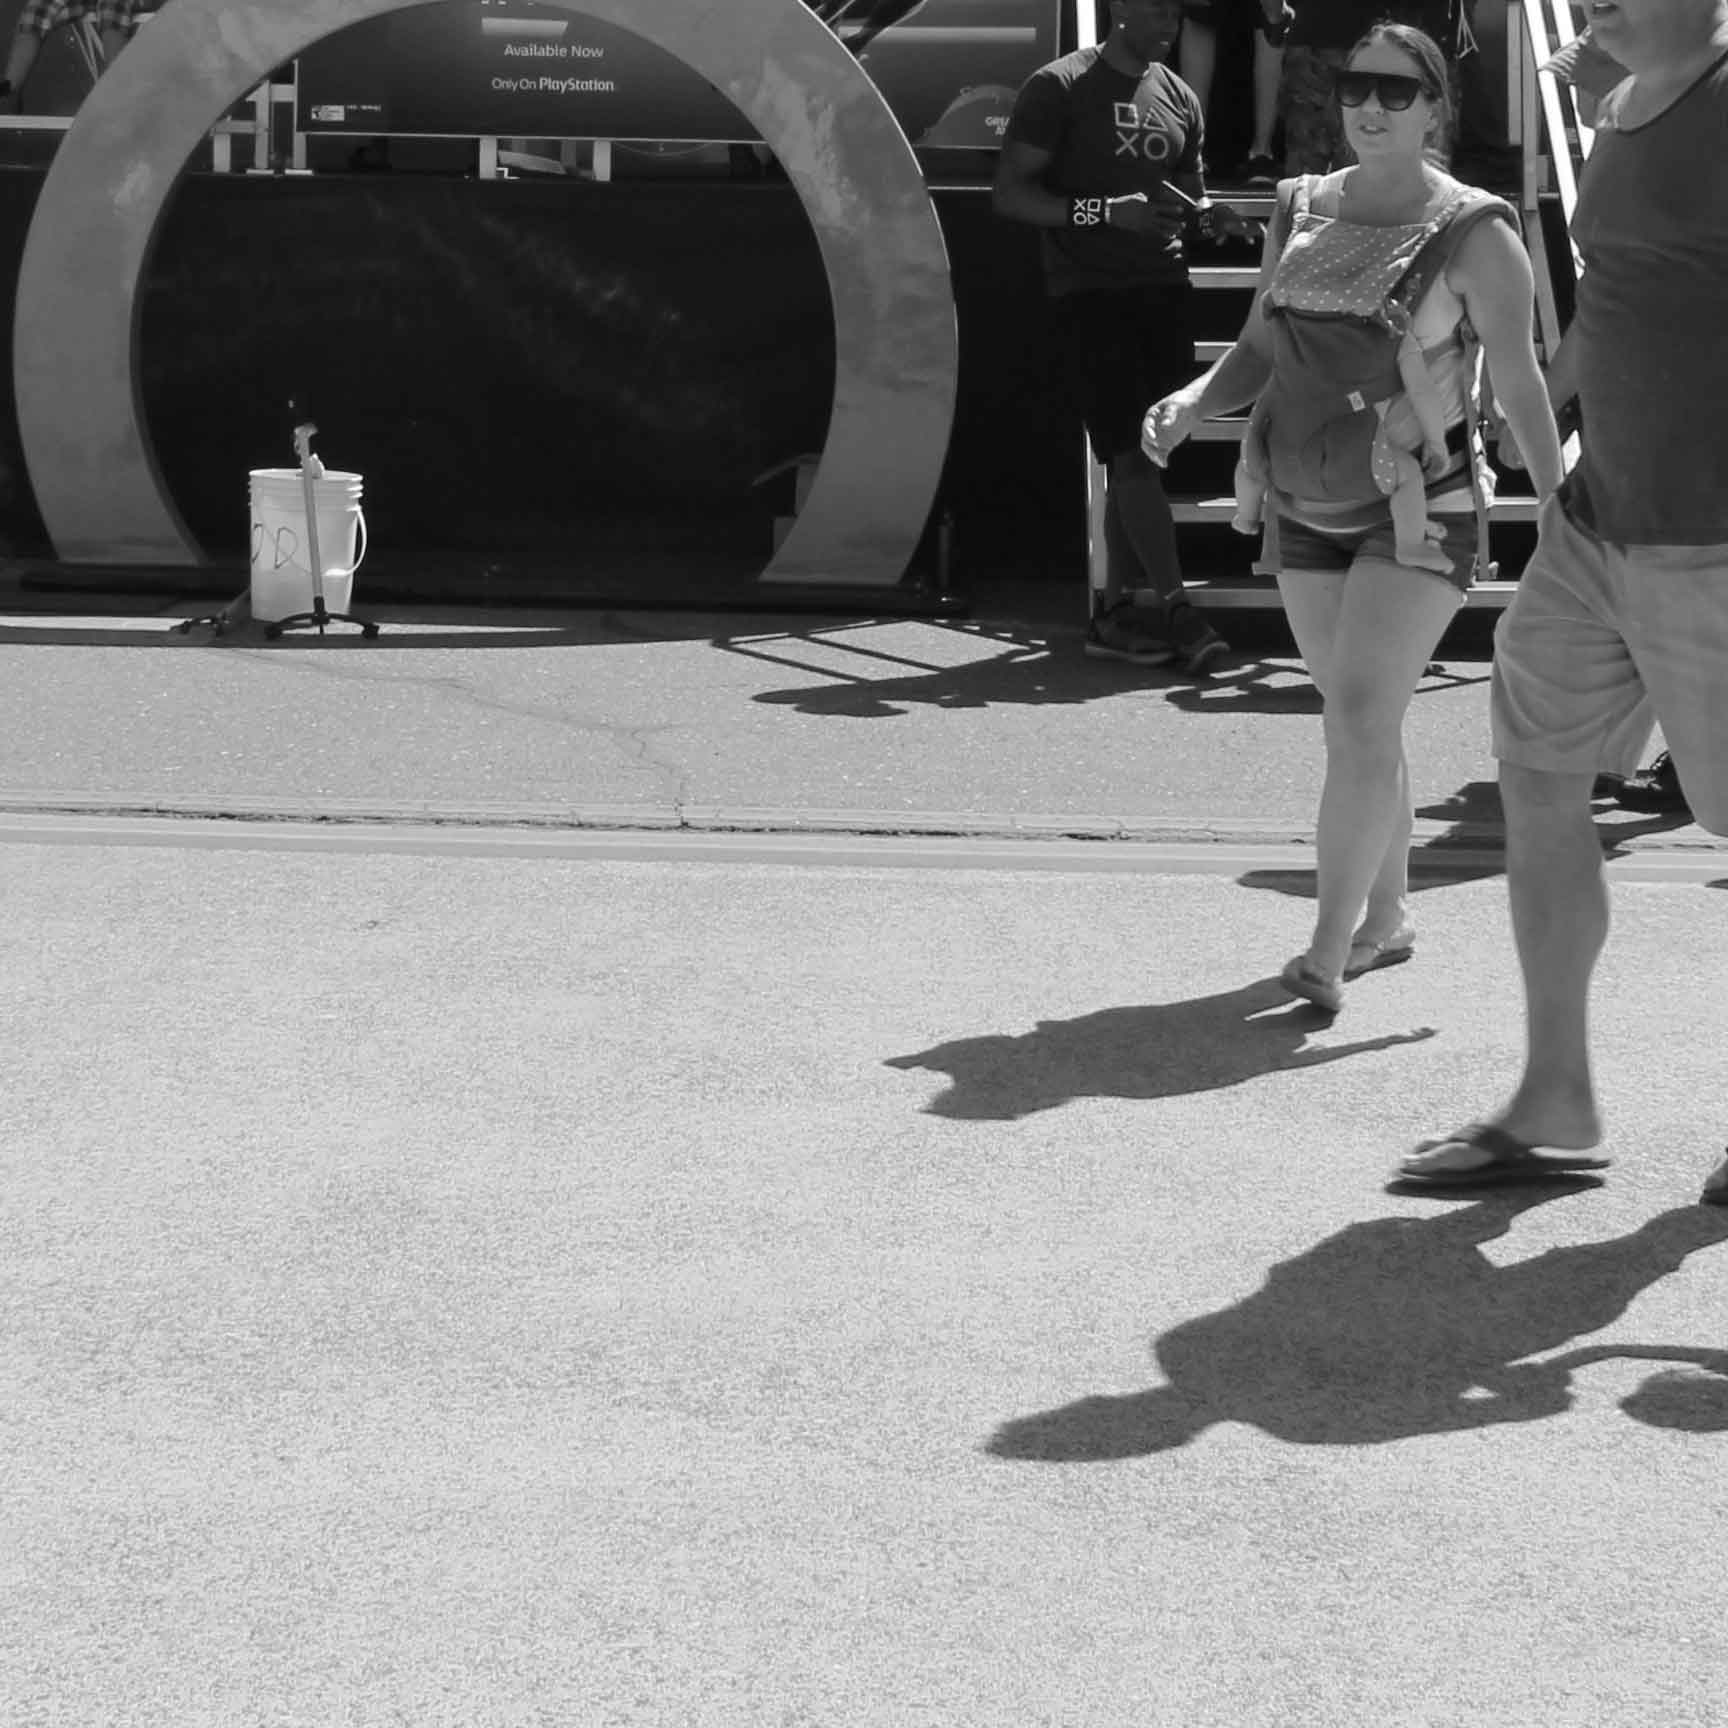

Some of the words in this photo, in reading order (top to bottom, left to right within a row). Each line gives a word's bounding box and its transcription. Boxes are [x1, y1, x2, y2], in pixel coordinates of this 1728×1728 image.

[504, 43, 568, 57] Available
[571, 45, 605, 58] Now
[491, 77, 518, 92] Only
[519, 78, 537, 89] On
[539, 76, 615, 94] PlayStation
